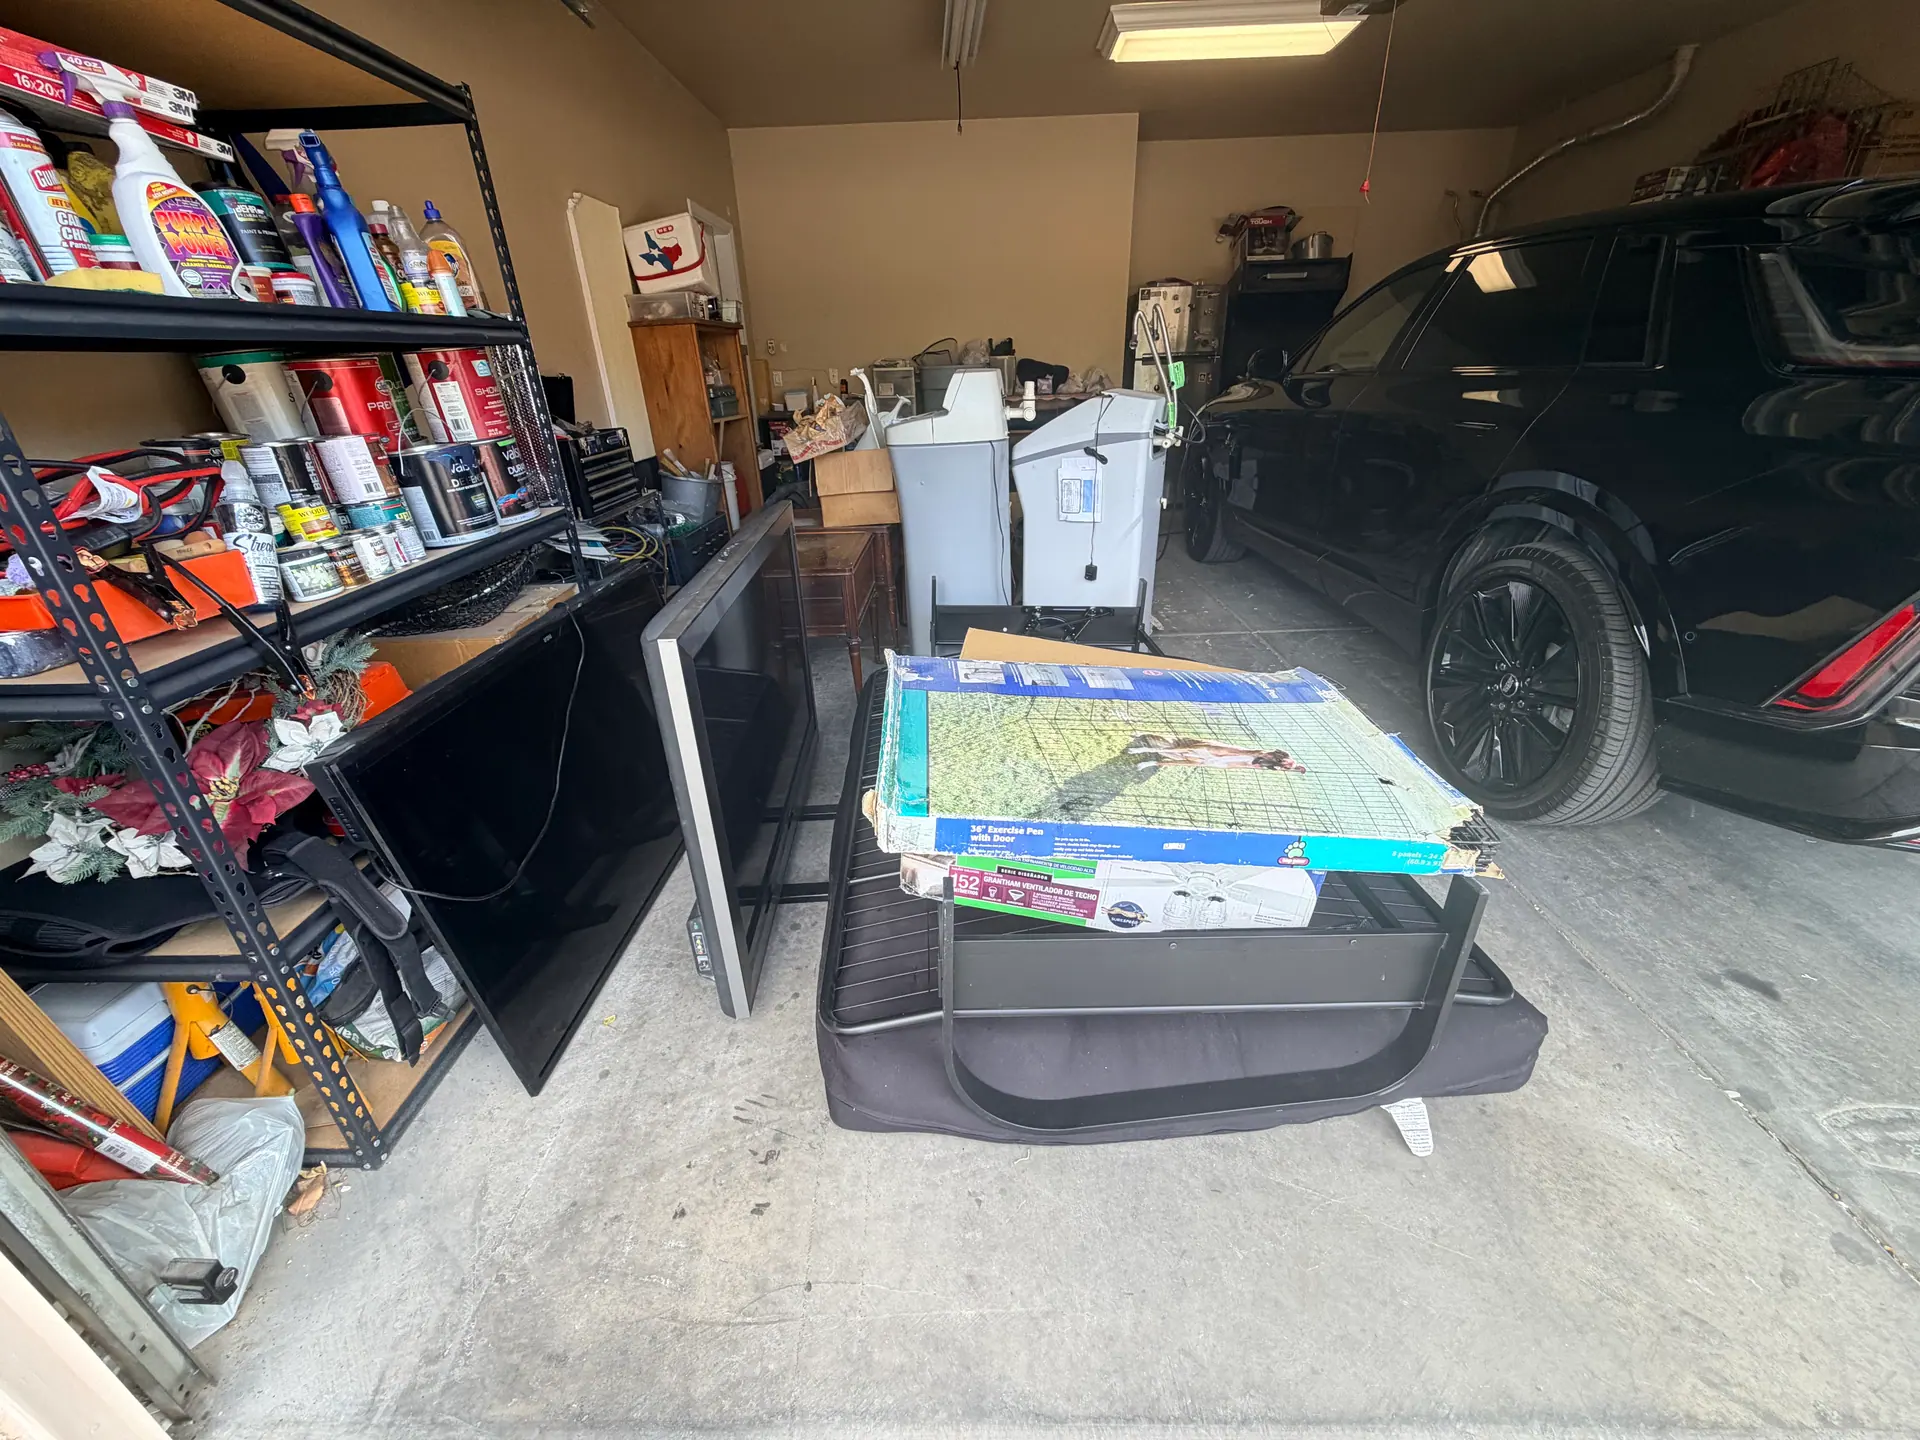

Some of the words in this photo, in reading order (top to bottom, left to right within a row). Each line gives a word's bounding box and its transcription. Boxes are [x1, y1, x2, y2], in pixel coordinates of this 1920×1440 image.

[67, 56, 82, 66] 40
[172, 88, 195, 104] 3M
[168, 101, 192, 117] 3M
[216, 143, 232, 156] 3M
[236, 203, 256, 214] BEHR
[153, 210, 226, 239] PURPLE
[162, 231, 235, 260] POWER
[305, 461, 322, 490] BEHR
[970, 833, 991, 842] with
[993, 834, 1016, 843] Door
[987, 825, 1025, 835] Exercise
[1026, 827, 1044, 836] Pen
[950, 872, 980, 891] 152
[983, 876, 1021, 888] GRANTHAM
[1022, 881, 1063, 895] VENTILADOR
[1064, 889, 1074, 897] DE
[1074, 890, 1097, 901] TECHO
[953, 887, 979, 896] NTÍMETROS
